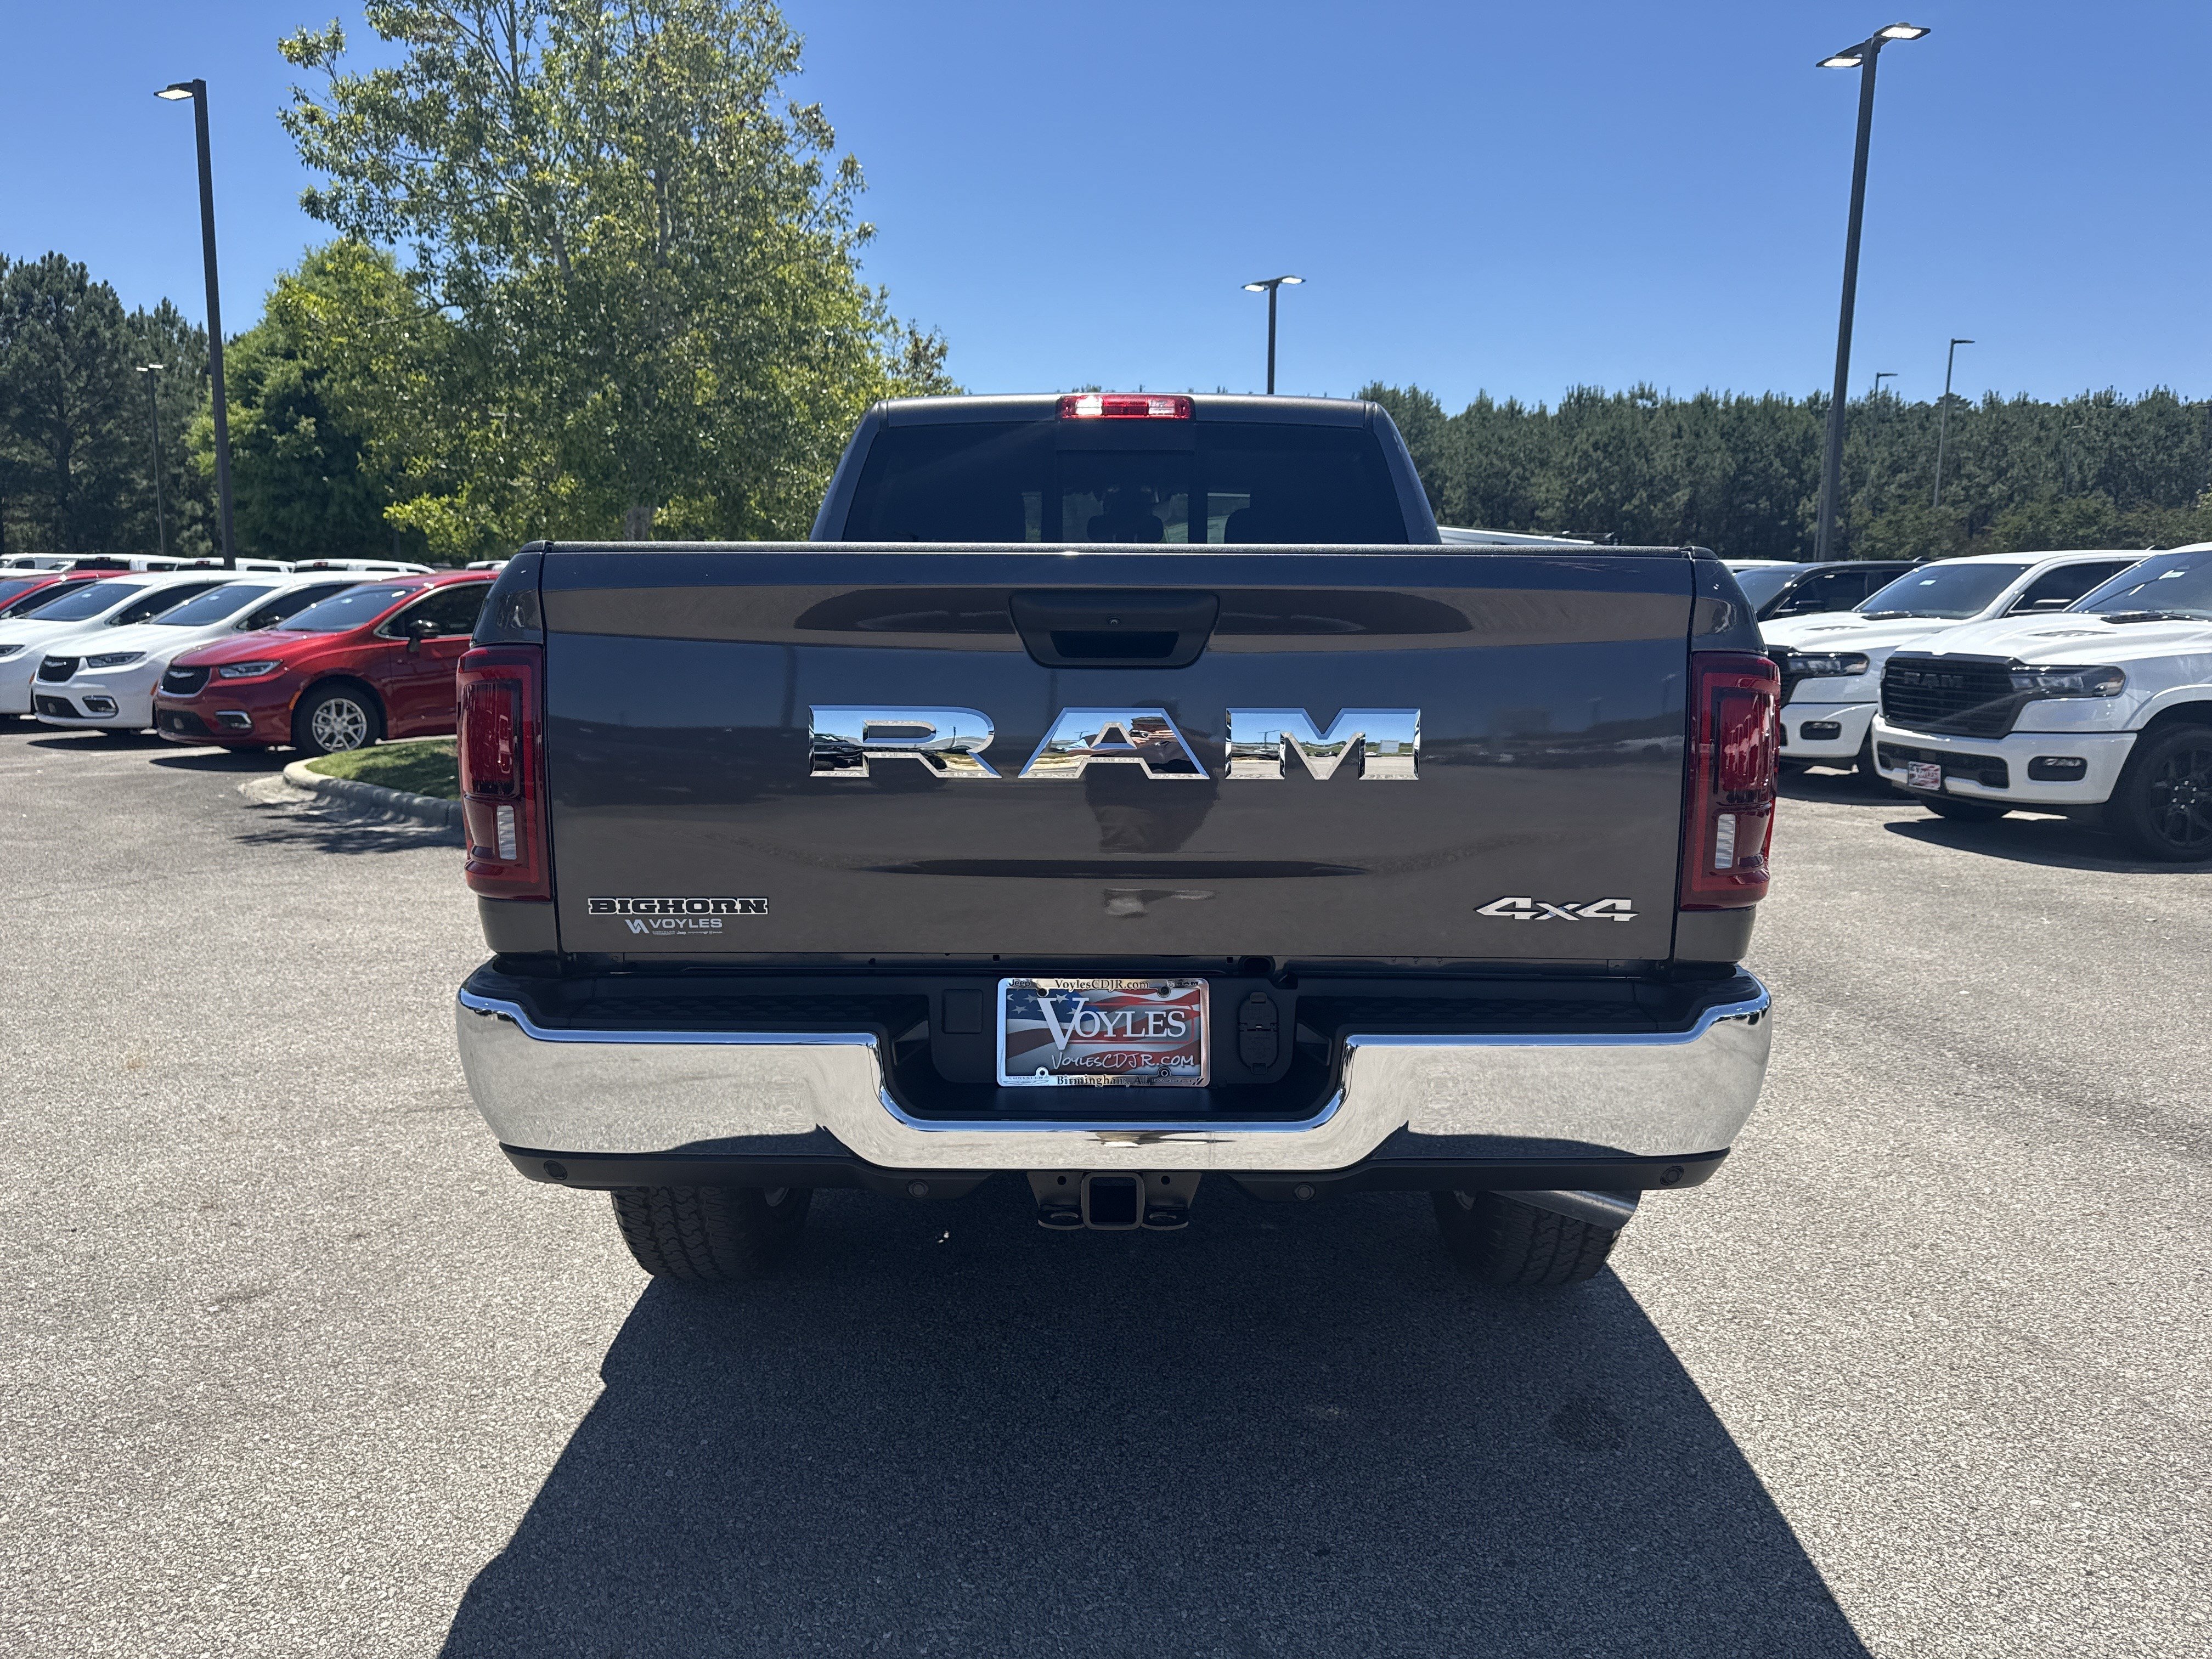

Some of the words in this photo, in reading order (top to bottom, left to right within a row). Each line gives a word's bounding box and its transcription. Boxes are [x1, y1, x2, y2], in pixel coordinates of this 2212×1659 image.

[809, 704, 1421, 780] RAM
[588, 898, 768, 915] BIGHORN
[1474, 896, 1640, 922] 4x4
[648, 918, 723, 928] VOYLES
[1008, 979, 1031, 988] Jeep
[1054, 979, 1149, 991] VoylesCDJR.com
[1037, 997, 1186, 1050] VOYLES
[1057, 1075, 1131, 1087] Birmingham,
[1135, 1075, 1150, 1085] AL
